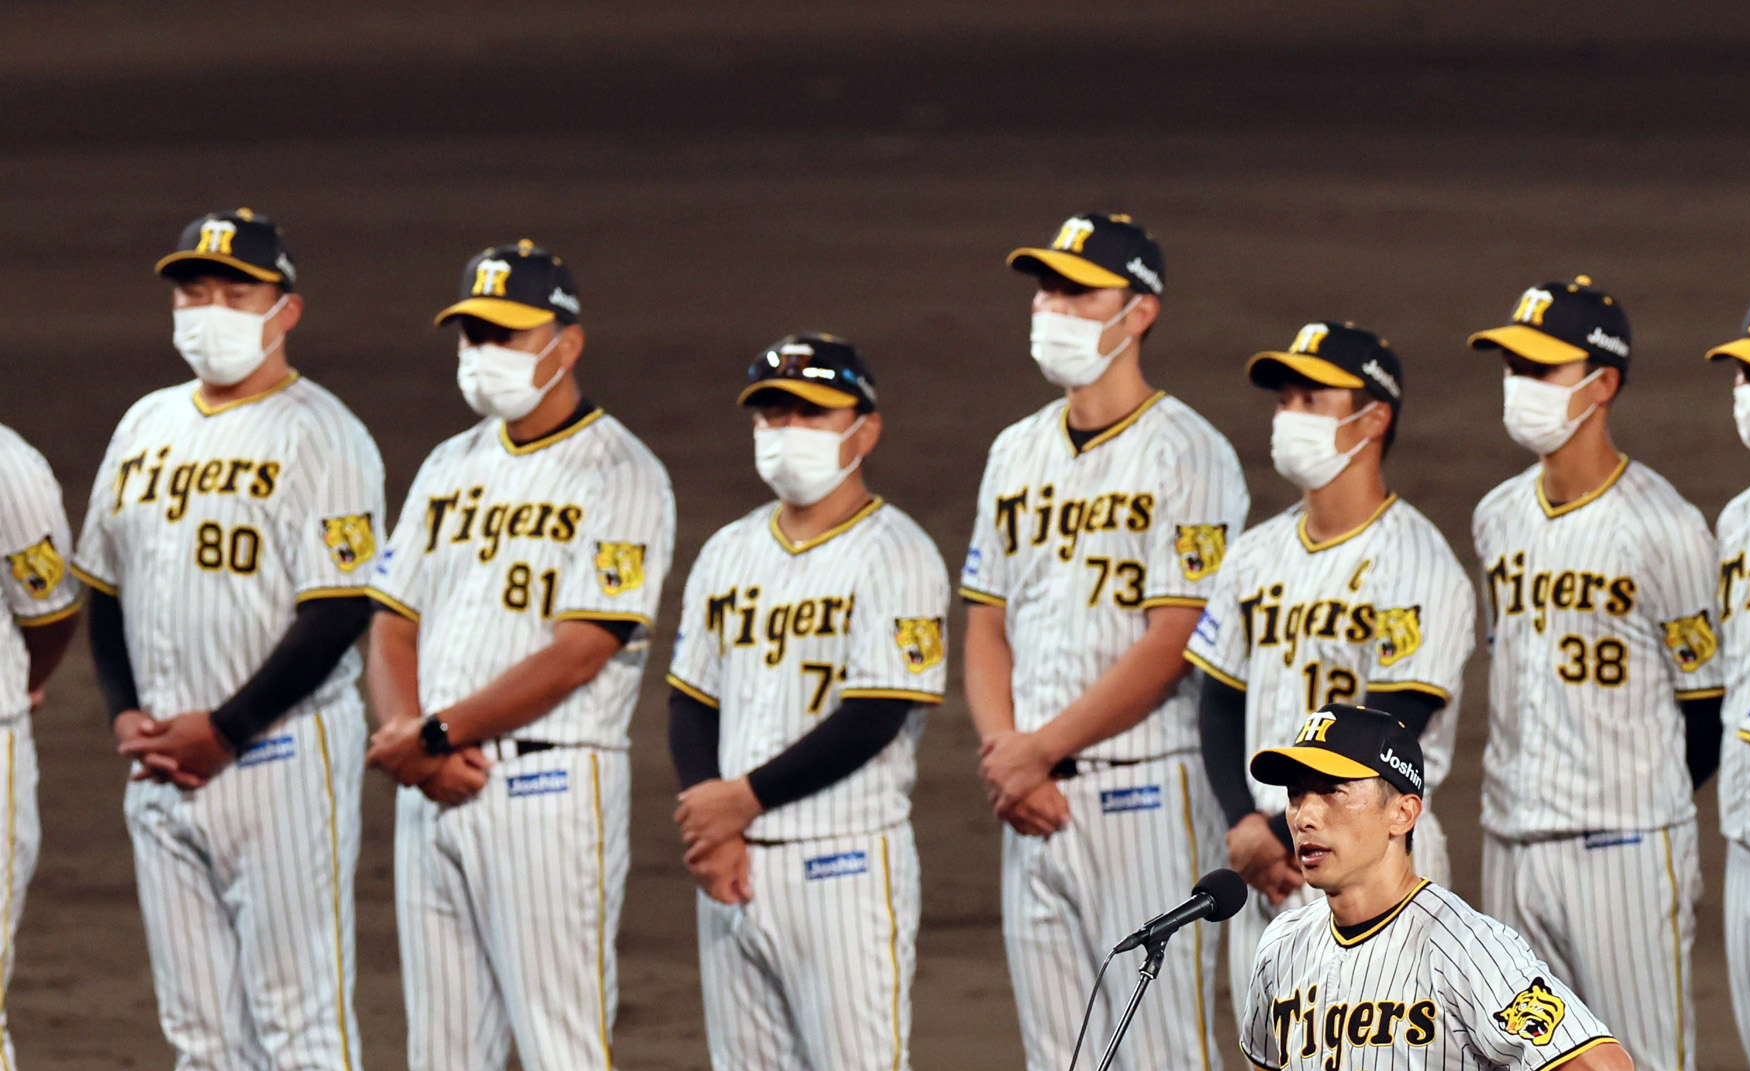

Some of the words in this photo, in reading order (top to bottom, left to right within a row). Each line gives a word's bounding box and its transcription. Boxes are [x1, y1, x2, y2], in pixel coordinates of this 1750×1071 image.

[113, 445, 281, 523] Tigers
[196, 520, 260, 575] 80
[425, 486, 582, 564] Tigers
[995, 484, 1154, 562] Tigers
[503, 561, 558, 620] 81
[1086, 557, 1147, 611] 73
[1348, 558, 1371, 593] C
[1485, 550, 1637, 634] Tigers
[706, 585, 855, 668] Tiger
[1240, 581, 1378, 668] Tigers
[801, 661, 848, 714] 7
[1557, 633, 1629, 688] 38
[1379, 748, 1423, 790] Joshin
